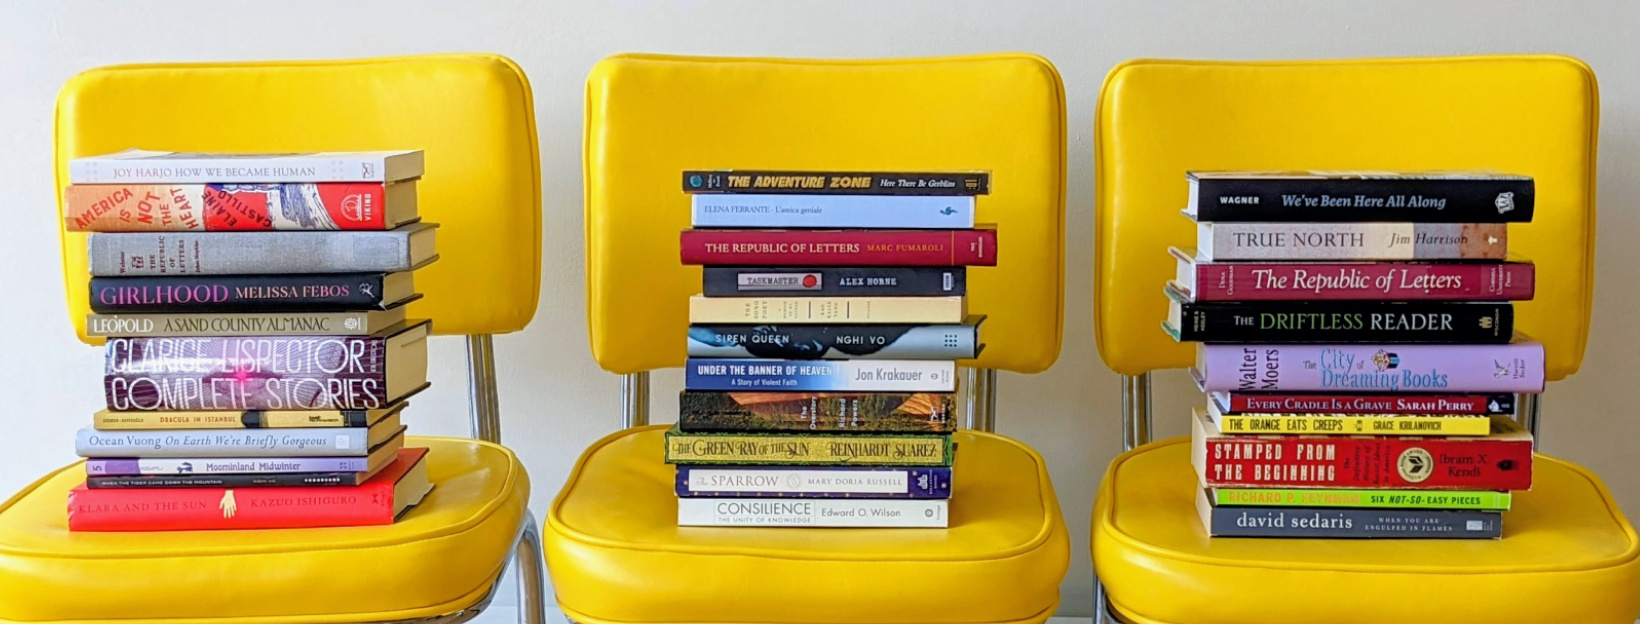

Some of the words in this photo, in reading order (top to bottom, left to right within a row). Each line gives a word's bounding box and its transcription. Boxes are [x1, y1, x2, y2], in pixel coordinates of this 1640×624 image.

[114, 168, 132, 178] JOY
[136, 168, 171, 178] HARJO
[175, 168, 202, 178] HOW
[205, 167, 222, 177] WE
[226, 167, 270, 177] BECAME
[273, 167, 316, 177] HUMAN
[728, 175, 751, 188] THE
[753, 176, 826, 188] ADVENTURE
[829, 176, 872, 188] ZONE
[880, 178, 896, 188] Here
[897, 178, 916, 188] There
[918, 179, 927, 188] Be
[75, 188, 133, 229] AMERICA
[119, 209, 131, 223] IS
[137, 192, 160, 225] NOT
[160, 204, 171, 226] THE
[170, 188, 199, 229] HEART
[202, 190, 237, 227] ELAINE
[364, 194, 372, 221] VIKING
[1220, 196, 1259, 204] WAGNER
[1281, 195, 1318, 207] We've
[1321, 195, 1352, 207] Been
[1354, 195, 1383, 207] Here
[1385, 195, 1405, 207] All
[1407, 195, 1446, 210] Along
[218, 191, 272, 228] CASTILLO
[800, 207, 822, 215] geniale
[1233, 232, 1285, 247] TRUE
[1293, 232, 1364, 247] NORTH
[1389, 233, 1410, 248] Jim
[1415, 233, 1468, 245] Harrison
[705, 243, 729, 253] THE
[732, 243, 788, 253] REPUBLIC
[790, 243, 807, 253] OF
[809, 243, 860, 253] LETTERS
[867, 244, 893, 252] MARC
[896, 244, 944, 252] FUMAROLI
[747, 277, 799, 285] TASKMASTER
[840, 278, 864, 286] ALEX
[867, 278, 897, 286] HORNE
[1251, 269, 1287, 289] The
[1292, 268, 1370, 293] Republic
[1375, 268, 1396, 293] of
[1400, 269, 1462, 289] Letters
[100, 285, 229, 305] GIRLHOOD
[236, 286, 298, 299] MELISSA
[302, 285, 350, 299] FEBOS
[164, 318, 173, 332] A
[174, 318, 209, 333] SAND
[211, 317, 265, 332] COUNTY
[267, 317, 330, 332] ALMANAC
[1233, 315, 1254, 326] THE
[1260, 313, 1363, 330] DRIFTLESS
[1370, 313, 1453, 331] READER
[715, 334, 747, 343] SIREN
[752, 334, 789, 344] QUEEN
[836, 336, 864, 345] NGHI
[870, 336, 885, 345] VO
[111, 339, 211, 374] CLARICE
[222, 339, 365, 374] LISPECTOR
[1303, 360, 1317, 370] The
[1320, 348, 1355, 374] City
[1357, 360, 1365, 369] of
[698, 365, 727, 376] UNDER
[730, 365, 745, 376] THE
[748, 365, 783, 376] BANNER
[786, 365, 797, 376] OF
[800, 366, 833, 376] HEAVEN
[855, 368, 874, 381] Jon
[876, 367, 922, 381] Krakauer
[1239, 348, 1257, 391] Walter
[1261, 349, 1279, 389] Moers
[1321, 368, 1400, 391] Dreaming
[1402, 369, 1448, 388] Books
[112, 377, 253, 410] COMPLETE
[265, 377, 380, 410] STORIES
[1247, 399, 1283, 409] EVERY
[1284, 398, 1329, 410] CRADLE
[1331, 398, 1342, 409] IS
[1354, 398, 1392, 410] GRAVE
[1397, 398, 1435, 411] SARAH
[1438, 399, 1474, 411] PERRY
[1229, 419, 1244, 431] THE
[1250, 419, 1281, 431] ORANGE
[1287, 419, 1307, 431] EATS
[1313, 419, 1343, 431] CREEPS
[1373, 420, 1394, 431] GRACE
[1399, 420, 1442, 431] KRILANOVICH
[89, 436, 124, 446] Ocean
[127, 436, 161, 449] Vuong
[165, 436, 180, 446] On
[184, 435, 212, 446] Earth
[215, 435, 241, 446] We're
[245, 435, 279, 449] Briefly
[282, 436, 327, 448] Gorgeous
[826, 441, 890, 462] REINHARDT
[893, 443, 937, 460] SUAREZ
[1214, 443, 1283, 460] STAMPED
[1296, 444, 1336, 460] FROM
[206, 462, 255, 471] Moominland
[259, 462, 301, 471] Midwinter
[1214, 464, 1243, 480] THE
[1254, 464, 1336, 481] BEGINNING
[1449, 467, 1480, 477] Kendi
[711, 475, 779, 486] SPARROW
[808, 478, 832, 486] MARY
[836, 478, 863, 486] DORIA
[866, 478, 902, 486] RUSSELL
[251, 498, 293, 508] KAZUO
[298, 496, 357, 506] ISHIGURO
[1230, 492, 1281, 503] RICHARD
[1287, 493, 1296, 502] P.
[1302, 492, 1360, 504] FEYNMAN
[1371, 495, 1384, 504] SIX
[1451, 496, 1481, 505] PIECES
[79, 504, 118, 514] KLARA
[122, 503, 150, 512] AND
[154, 502, 178, 511] THE
[183, 501, 207, 510] SUN
[717, 502, 811, 515] CONSILIENCE
[821, 507, 855, 517] Edward
[858, 508, 869, 518] O.
[871, 507, 901, 517] Wilson
[1236, 511, 1284, 528] david
[1291, 513, 1353, 529] sedaris
